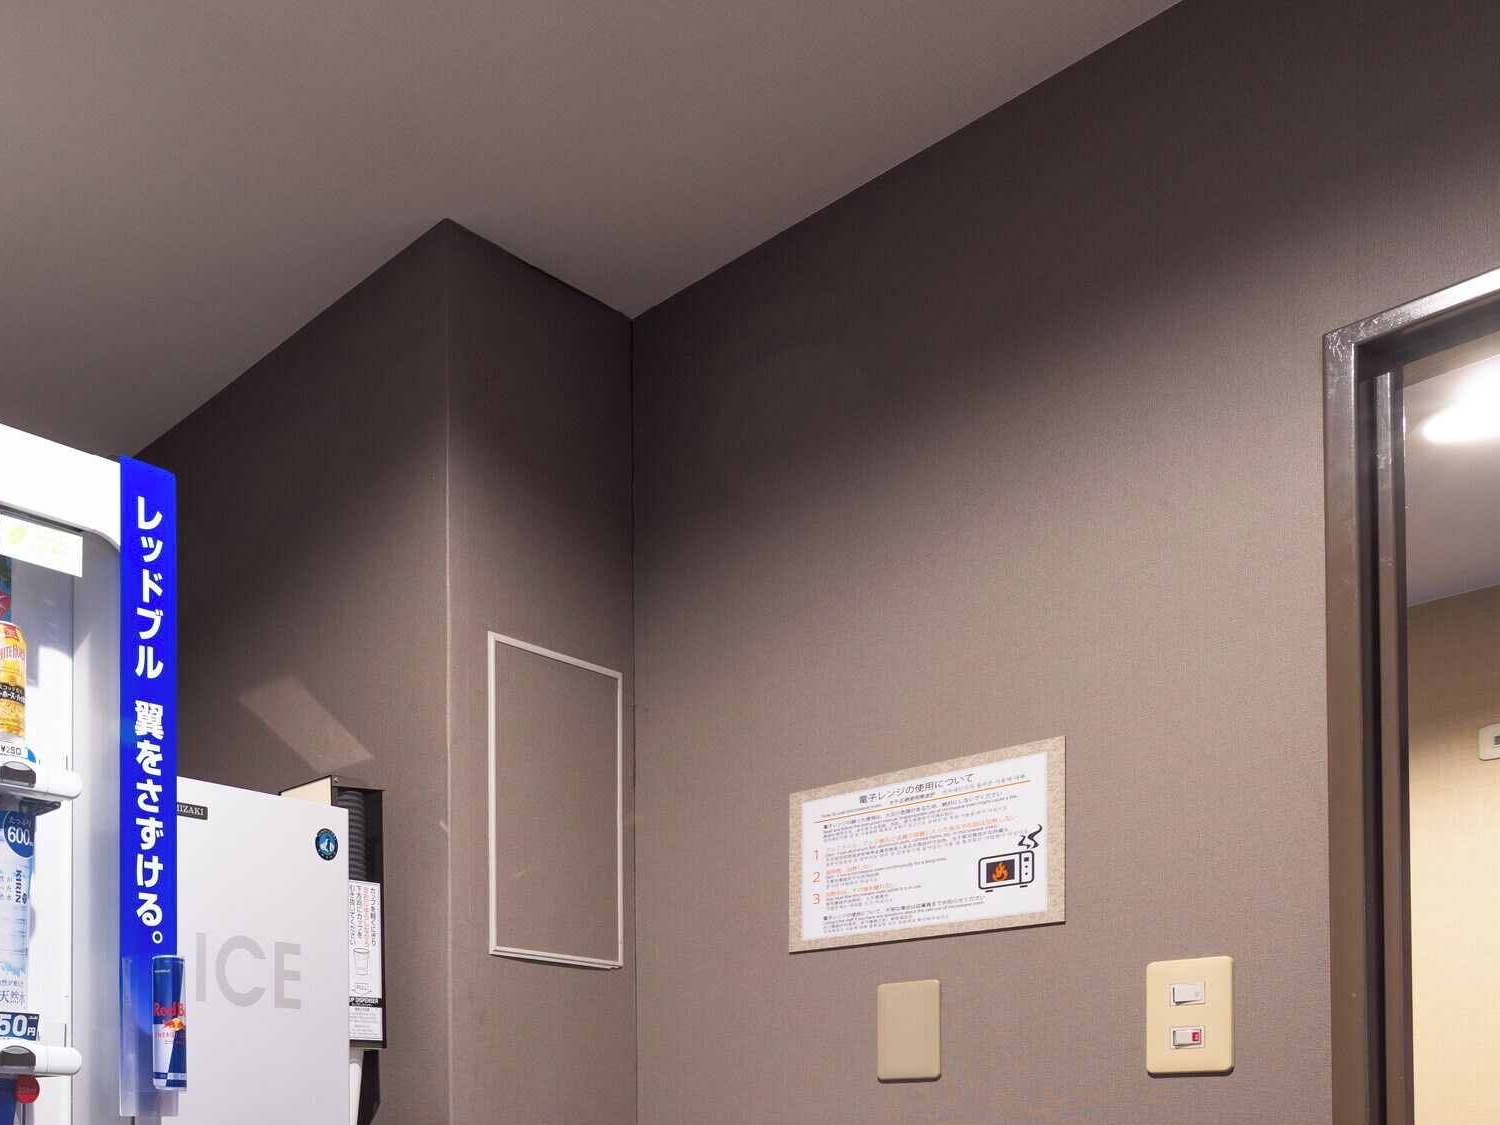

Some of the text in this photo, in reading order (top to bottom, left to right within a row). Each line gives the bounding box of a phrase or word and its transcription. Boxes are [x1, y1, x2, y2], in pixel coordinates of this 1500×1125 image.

[133, 495, 165, 945] レッドブル 翼をさずける。
[1, 745, 22, 756] ¥250
[859, 773, 974, 804] 電子レンジの使用について
[813, 850, 819, 861] 1
[813, 871, 821, 883] 2
[813, 893, 821, 905] 3
[196, 932, 302, 1011] ICE
